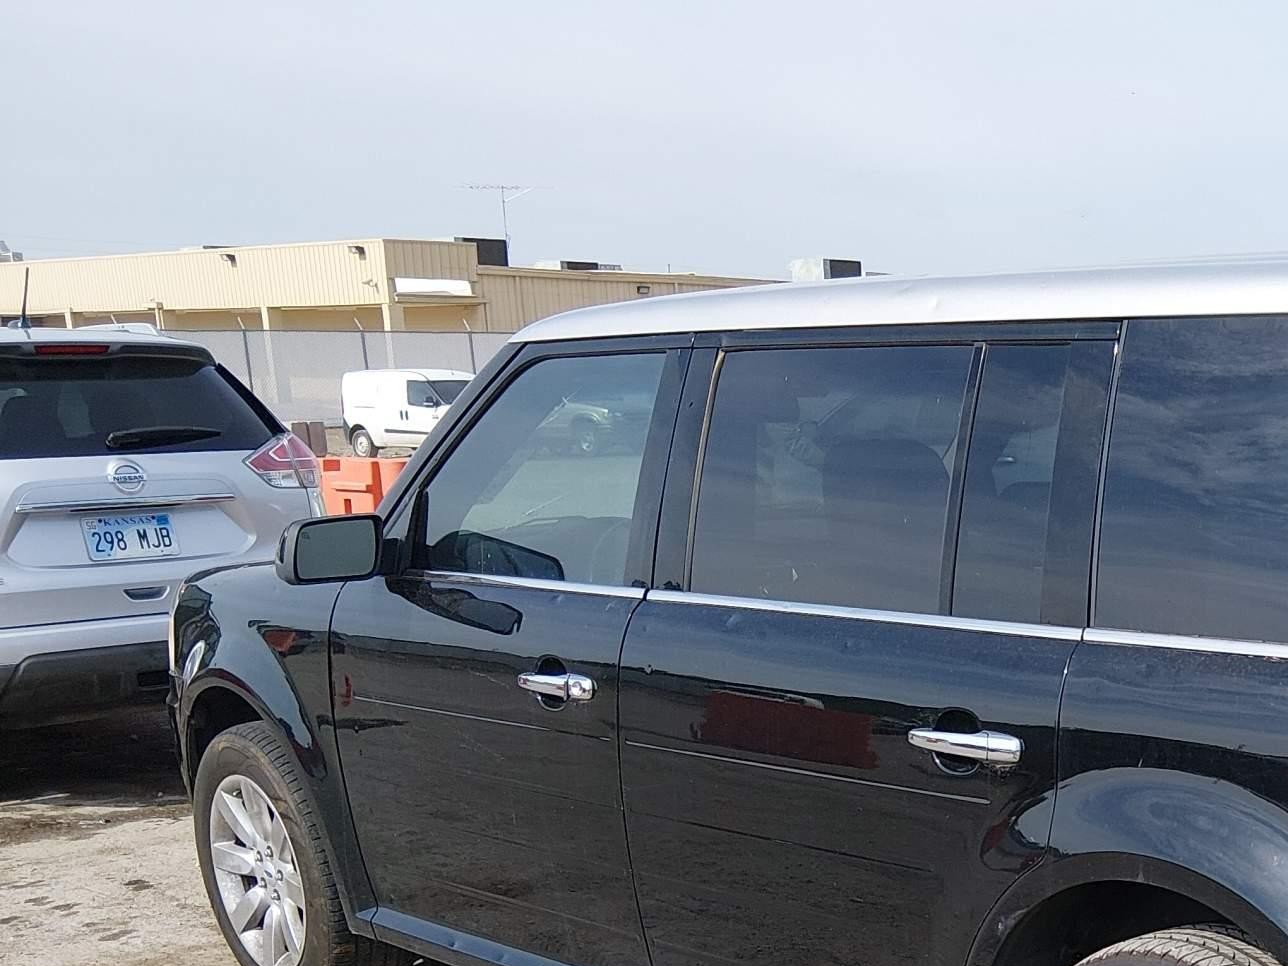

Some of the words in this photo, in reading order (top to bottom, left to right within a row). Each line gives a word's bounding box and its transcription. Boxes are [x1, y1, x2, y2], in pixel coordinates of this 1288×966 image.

[103, 515, 152, 527] KANSAS
[91, 530, 127, 553] 298
[136, 527, 172, 549] MJB
